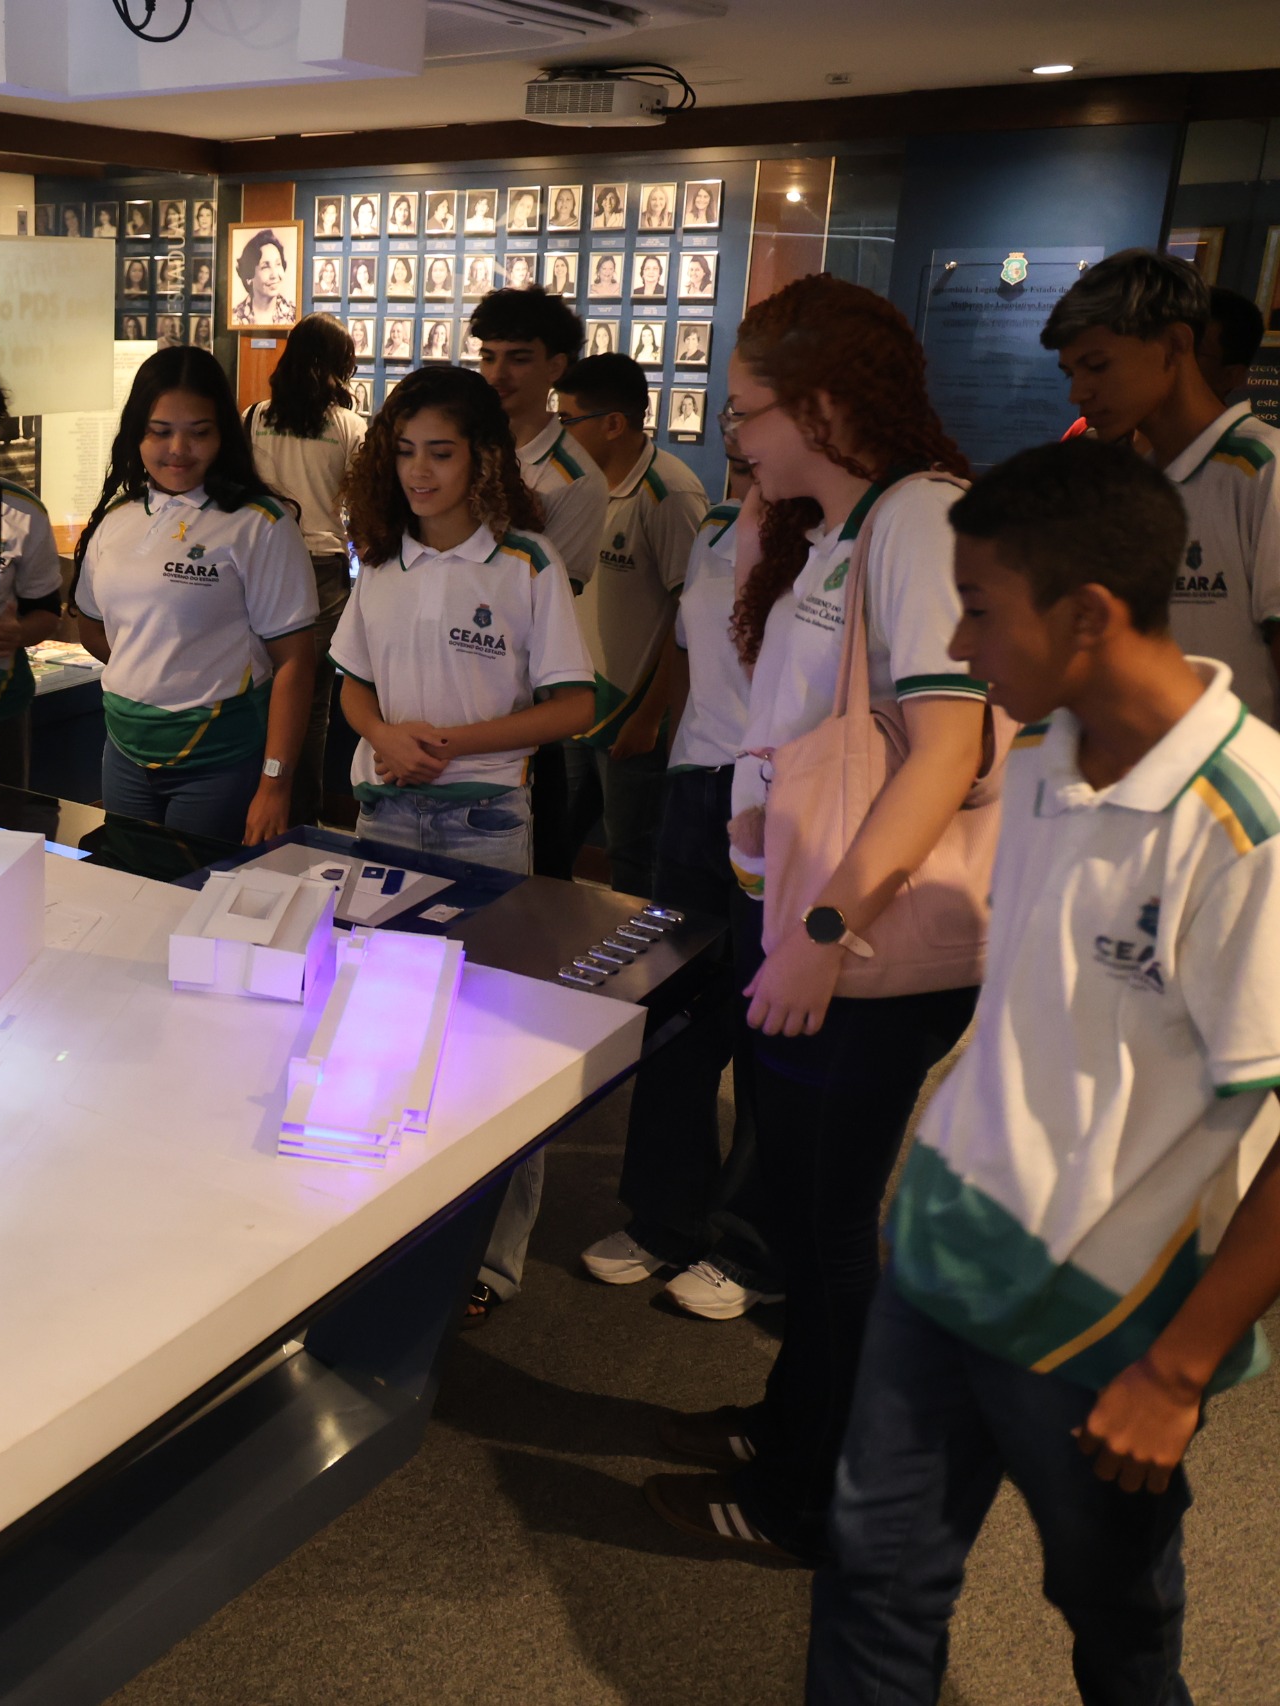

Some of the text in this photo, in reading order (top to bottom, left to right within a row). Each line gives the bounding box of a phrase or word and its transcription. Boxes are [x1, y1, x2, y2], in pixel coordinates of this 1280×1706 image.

[164, 562, 218, 577] CEARÁ
[1173, 571, 1228, 591] EARÁ
[450, 628, 506, 651] CEARÁ
[484, 648, 506, 656] ESTADO
